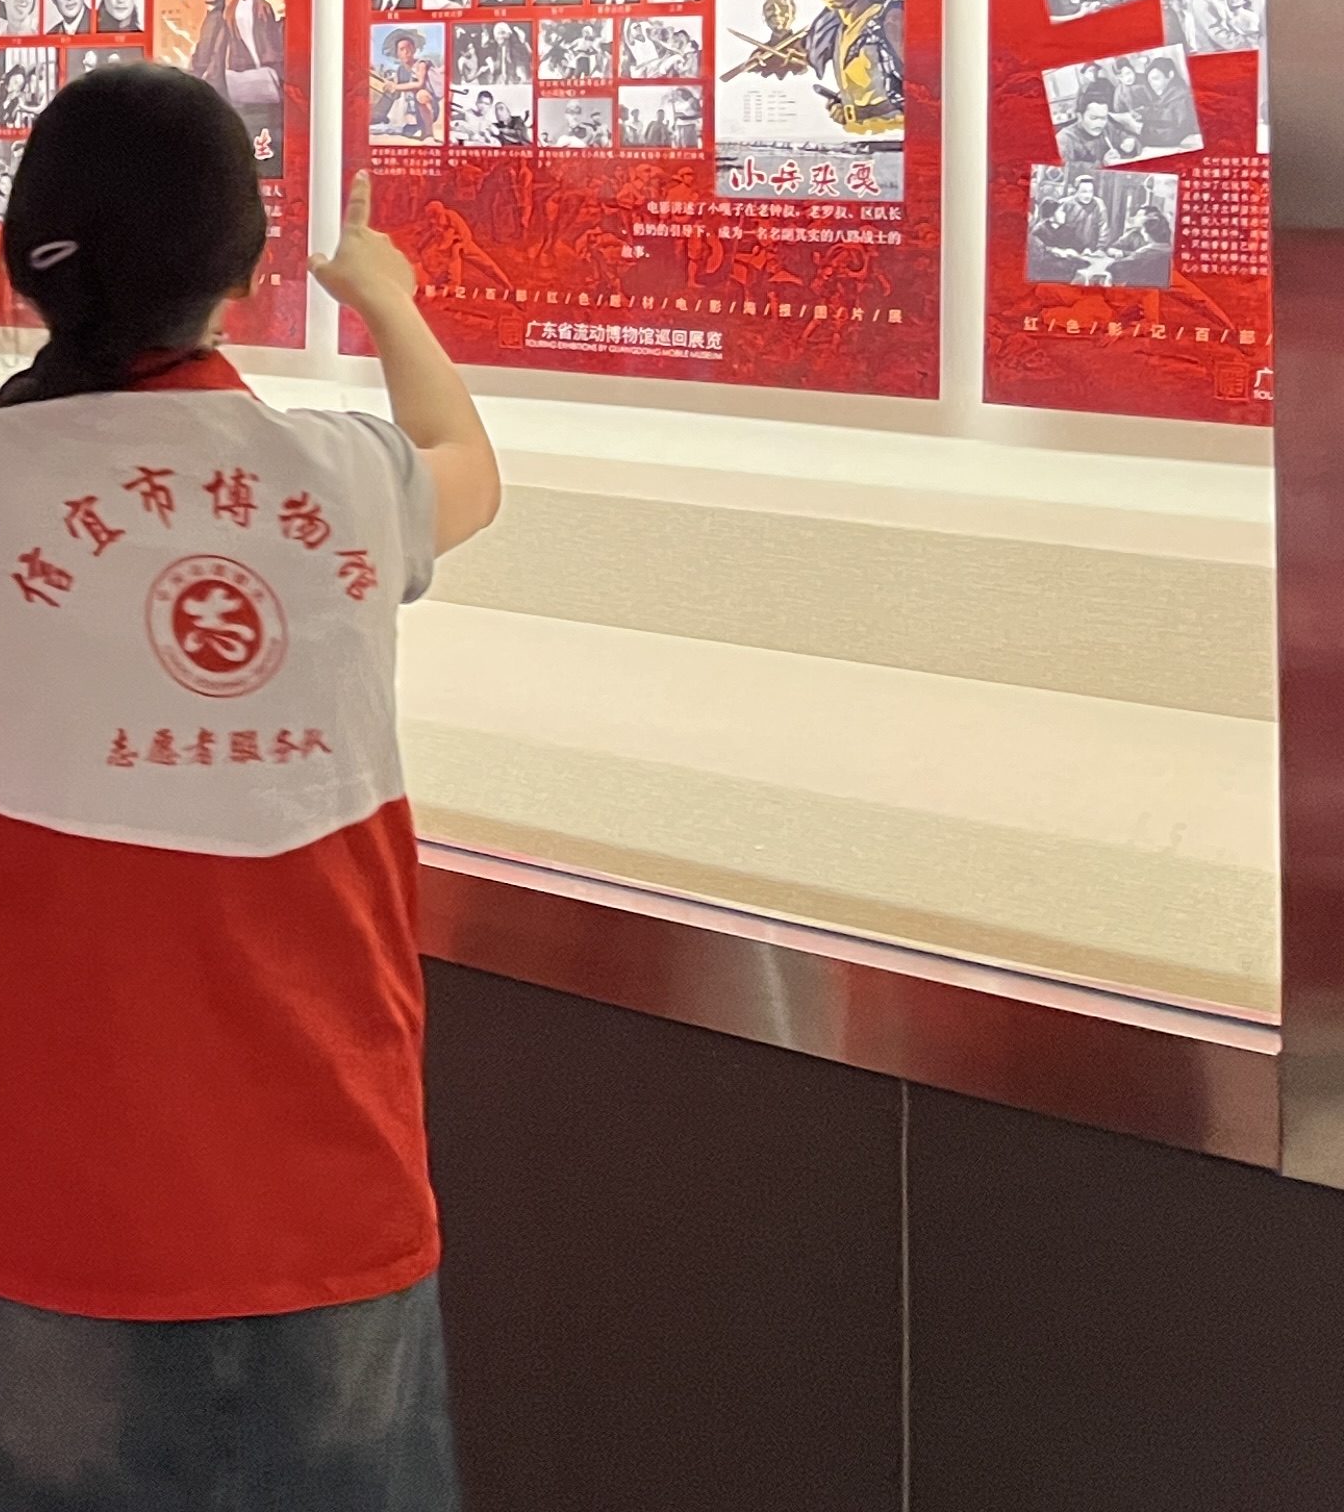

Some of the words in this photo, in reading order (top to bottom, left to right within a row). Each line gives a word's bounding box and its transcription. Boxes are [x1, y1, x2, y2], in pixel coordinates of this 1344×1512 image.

[729, 155, 882, 197] 小兵张嘎
[621, 245, 651, 259] 故事。
[525, 320, 723, 350] 广东省流动博物馆巡回展览
[107, 727, 333, 768] 志愿者服务队
